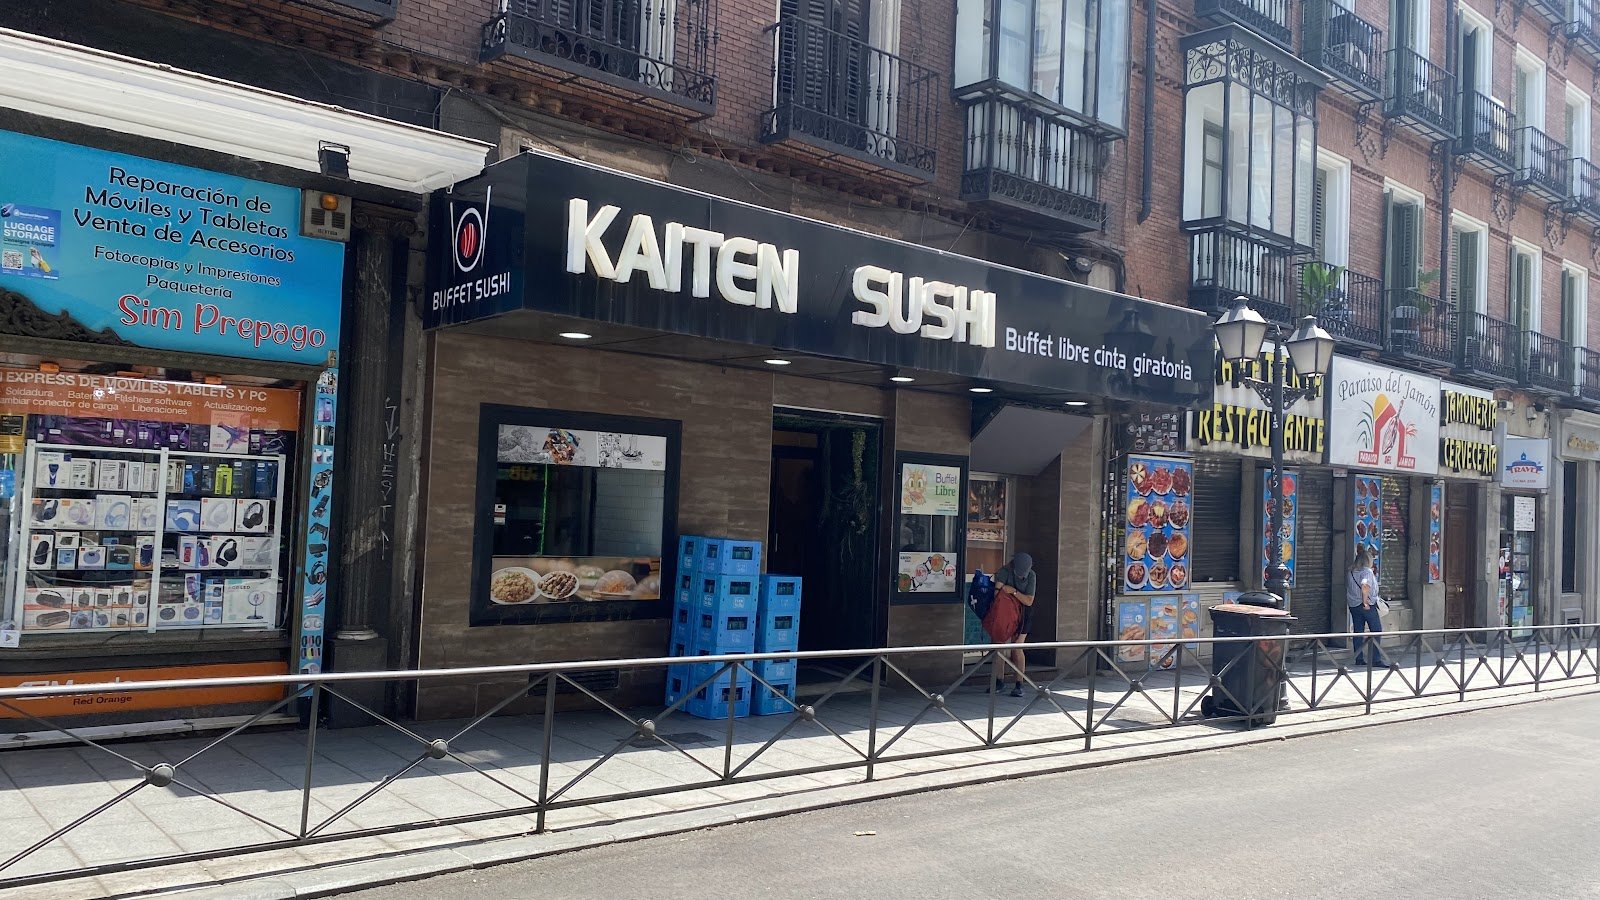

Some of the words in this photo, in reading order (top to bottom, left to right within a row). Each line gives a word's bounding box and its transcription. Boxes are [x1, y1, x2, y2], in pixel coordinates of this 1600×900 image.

[109, 166, 239, 207] Reparación
[245, 192, 272, 214] de
[4, 221, 54, 235] LUGGAGE
[85, 186, 171, 218] Móviles
[179, 205, 192, 224] y
[199, 207, 288, 240] Tabletas
[4, 229, 54, 242] STORAGE
[73, 208, 146, 238] Venta
[154, 220, 182, 244] de
[189, 229, 295, 262] Accesorios
[94, 245, 180, 271] Fotocopias
[184, 262, 193, 276] y
[198, 262, 281, 287] Impresiones
[566, 197, 799, 314] KAITEN
[851, 264, 997, 348] SUSHI
[147, 274, 233, 299] Paquetería
[432, 282, 472, 311] BUFFET
[475, 271, 510, 300] SUSHI
[118, 294, 182, 330] Sim
[194, 303, 326, 351] Prepago
[1005, 327, 1053, 358] Buffet
[1058, 336, 1090, 363] libre
[1094, 344, 1127, 370] cinta
[1133, 351, 1192, 381] giratoria
[6, 387, 54, 397] Soldadura
[68, 390, 101, 400] Bater
[155, 396, 192, 407] software
[204, 401, 267, 413] Actualizaciones
[7, 372, 76, 386] EXPRESS
[79, 375, 100, 388] DE
[175, 383, 234, 399] TABLETS
[238, 389, 247, 399] Y
[250, 391, 267, 401] PC
[1385, 371, 1403, 394] del
[1403, 380, 1436, 418] Jamón
[33, 399, 76, 408] conector
[78, 400, 91, 409] de
[93, 402, 119, 411] carga
[132, 404, 188, 415] Liberaciones
[1198, 403, 1324, 453] RESTAUANTE
[935, 472, 957, 485] Buffet
[935, 485, 956, 497] Libre
[73, 697, 93, 706] Red
[96, 696, 133, 704] Orange
